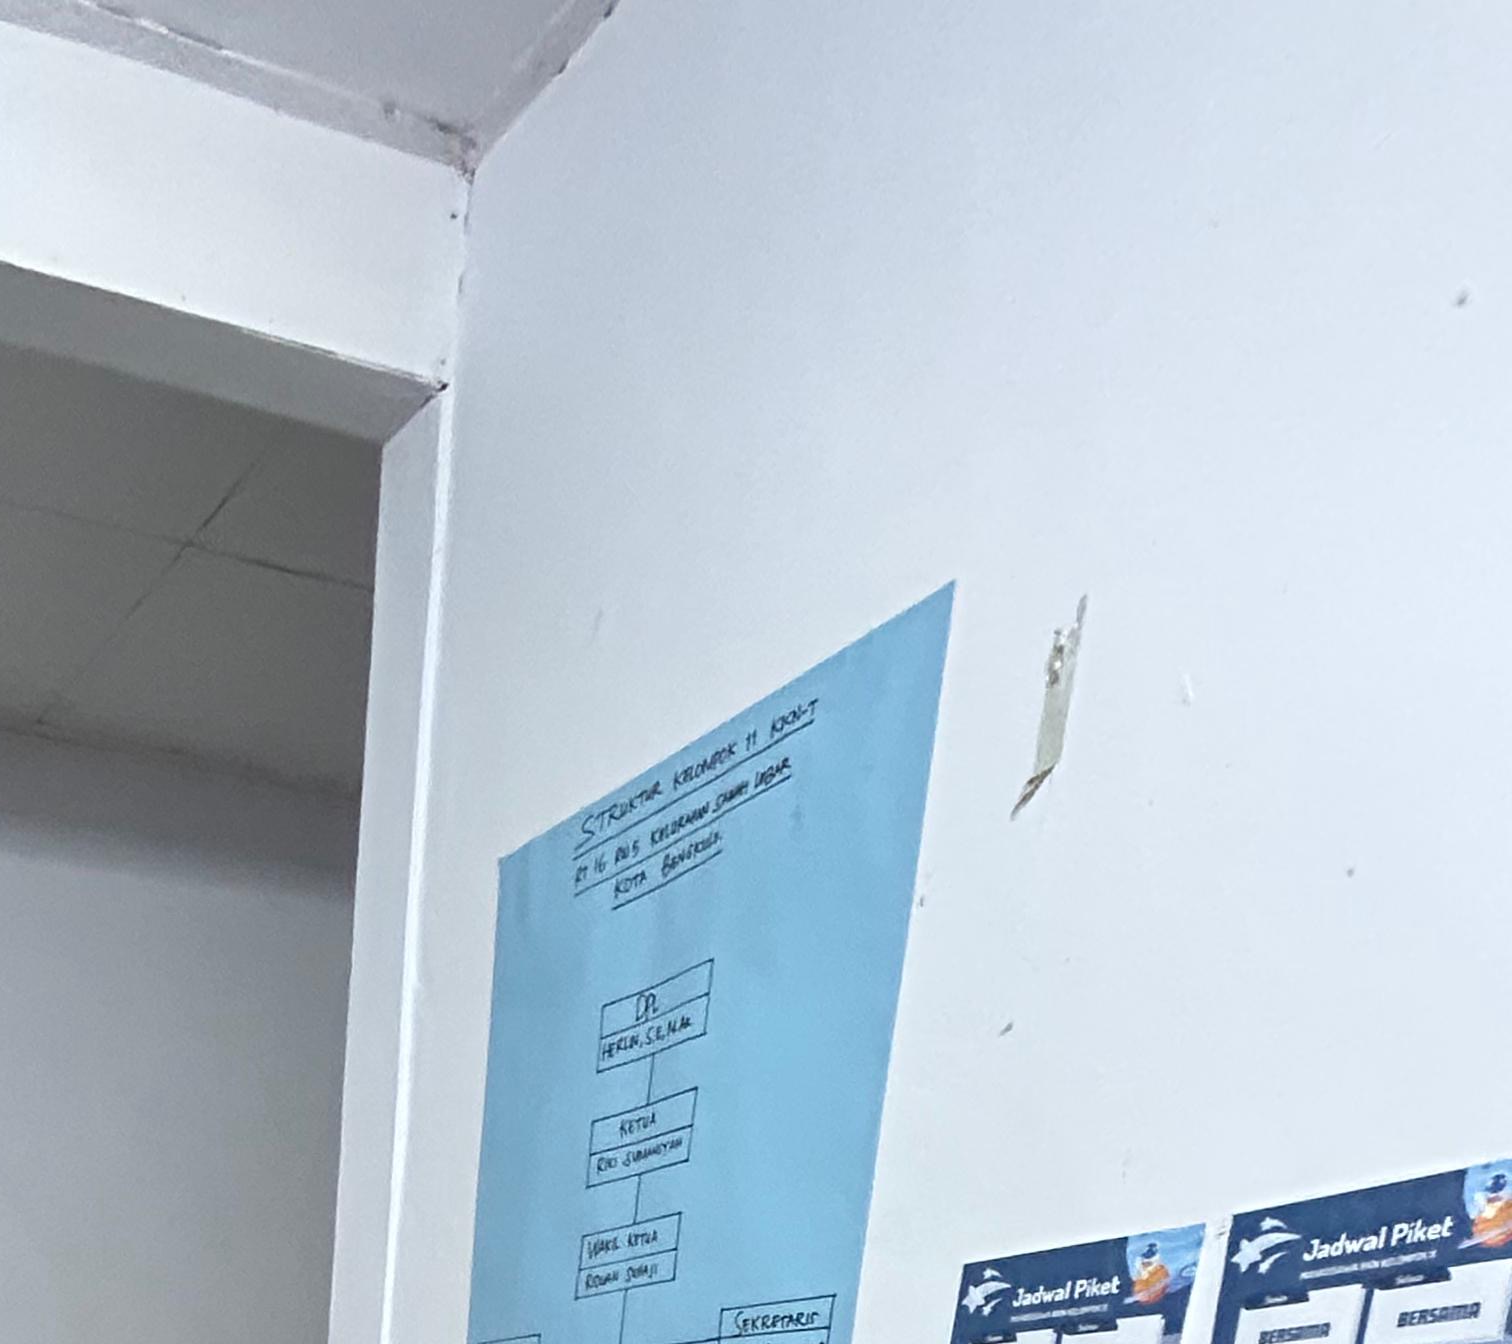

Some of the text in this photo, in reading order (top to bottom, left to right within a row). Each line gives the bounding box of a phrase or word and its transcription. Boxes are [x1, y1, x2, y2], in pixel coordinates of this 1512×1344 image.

[574, 780, 662, 850] STRUKTUR
[619, 1112, 657, 1138] KETUA
[1303, 1216, 1455, 1261] Jadwal Piket
[1012, 1275, 1121, 1307] Jadwal Piket
[735, 1311, 820, 1334] SEKRETARIS
[1397, 1302, 1481, 1327] BERSAMA
[1258, 1322, 1331, 1344] BERSAMA
